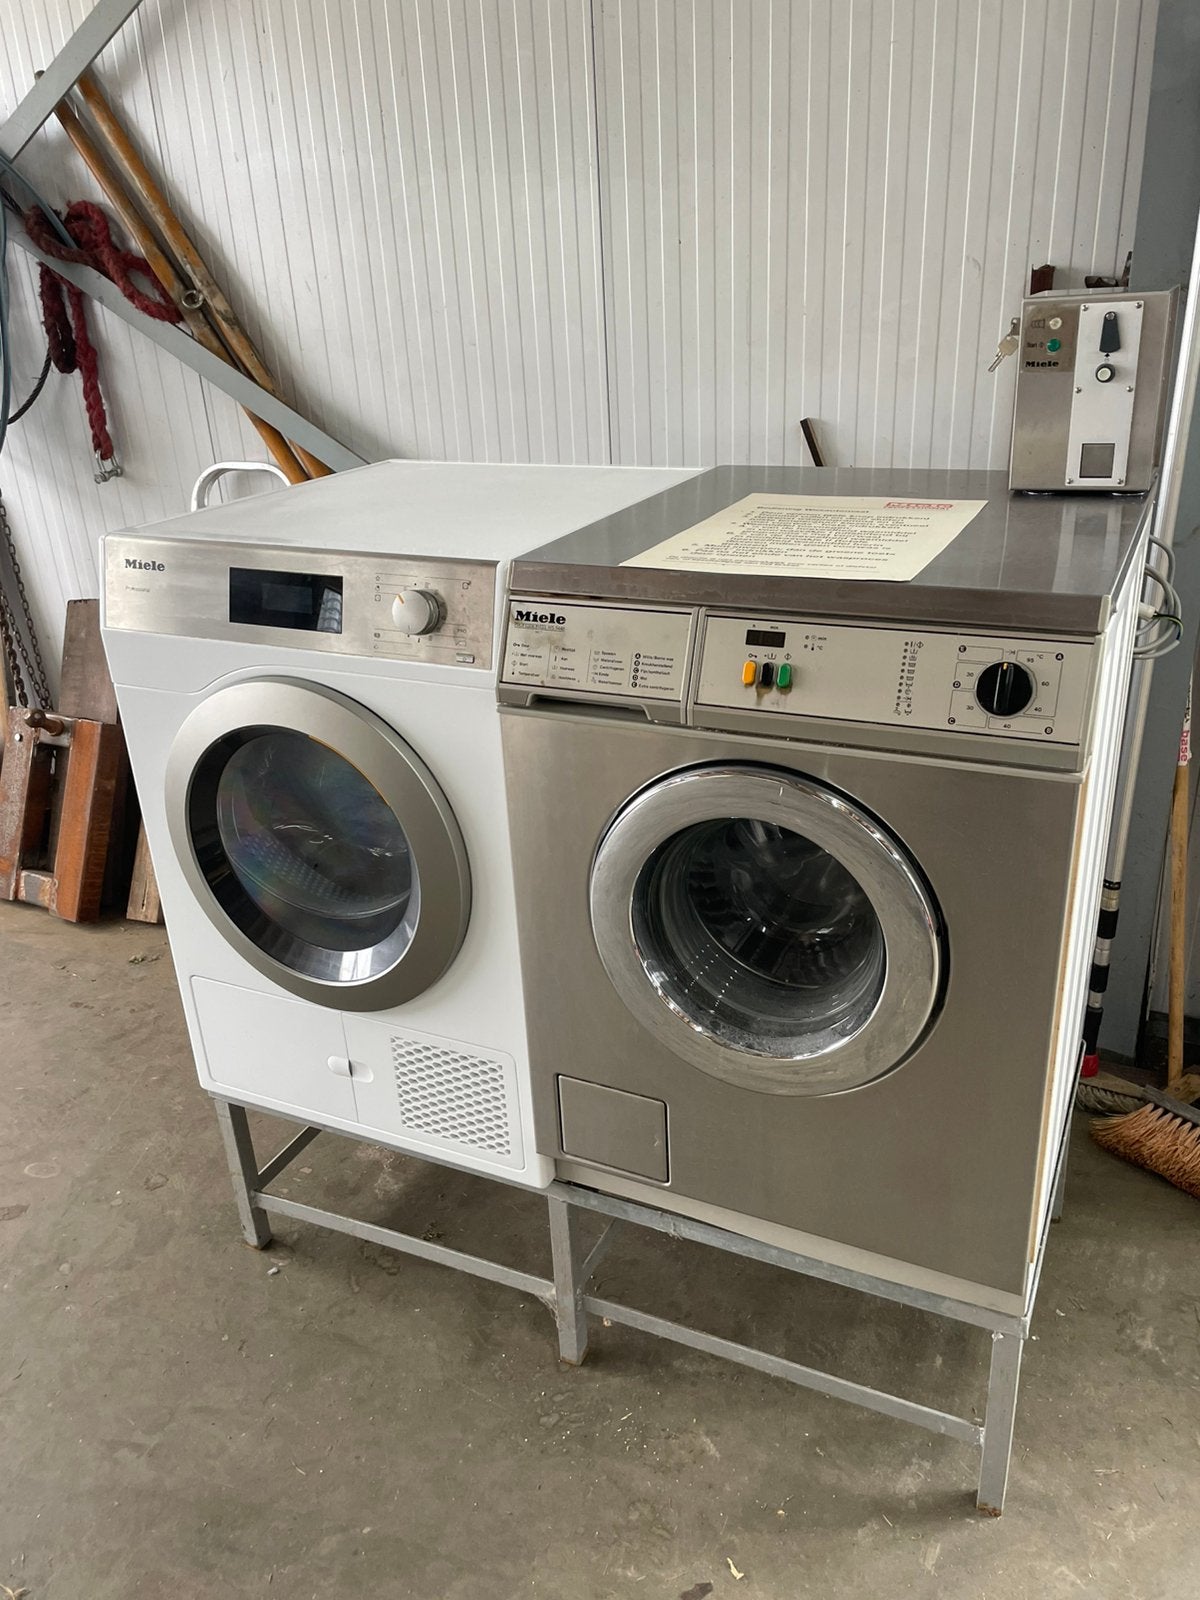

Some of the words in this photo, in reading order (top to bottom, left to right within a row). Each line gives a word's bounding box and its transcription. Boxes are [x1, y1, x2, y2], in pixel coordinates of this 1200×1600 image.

[124, 559, 165, 571] Miele
[515, 610, 566, 624] Miele
[948, 717, 956, 725] C
[1180, 730, 1189, 761] base
